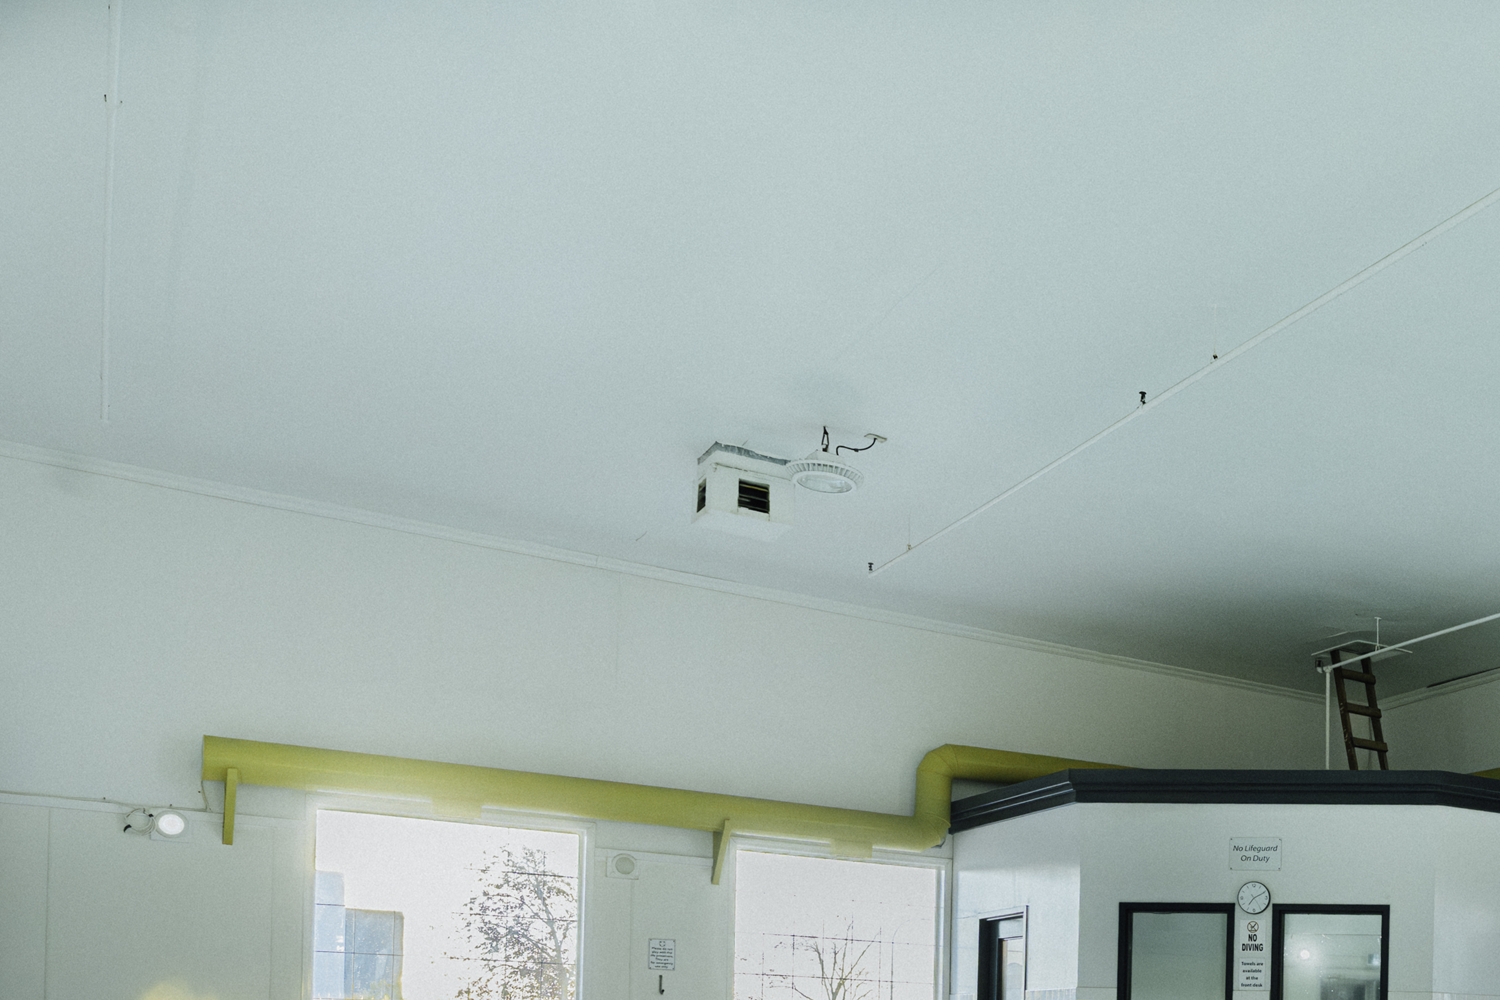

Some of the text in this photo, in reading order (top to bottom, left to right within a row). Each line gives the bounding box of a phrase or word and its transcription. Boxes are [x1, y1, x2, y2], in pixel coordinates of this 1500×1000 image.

[1244, 845, 1278, 853] Lifeguard
[1240, 854, 1270, 863] On Duty
[1248, 934, 1257, 942] NO
[1241, 943, 1264, 952] DIVING
